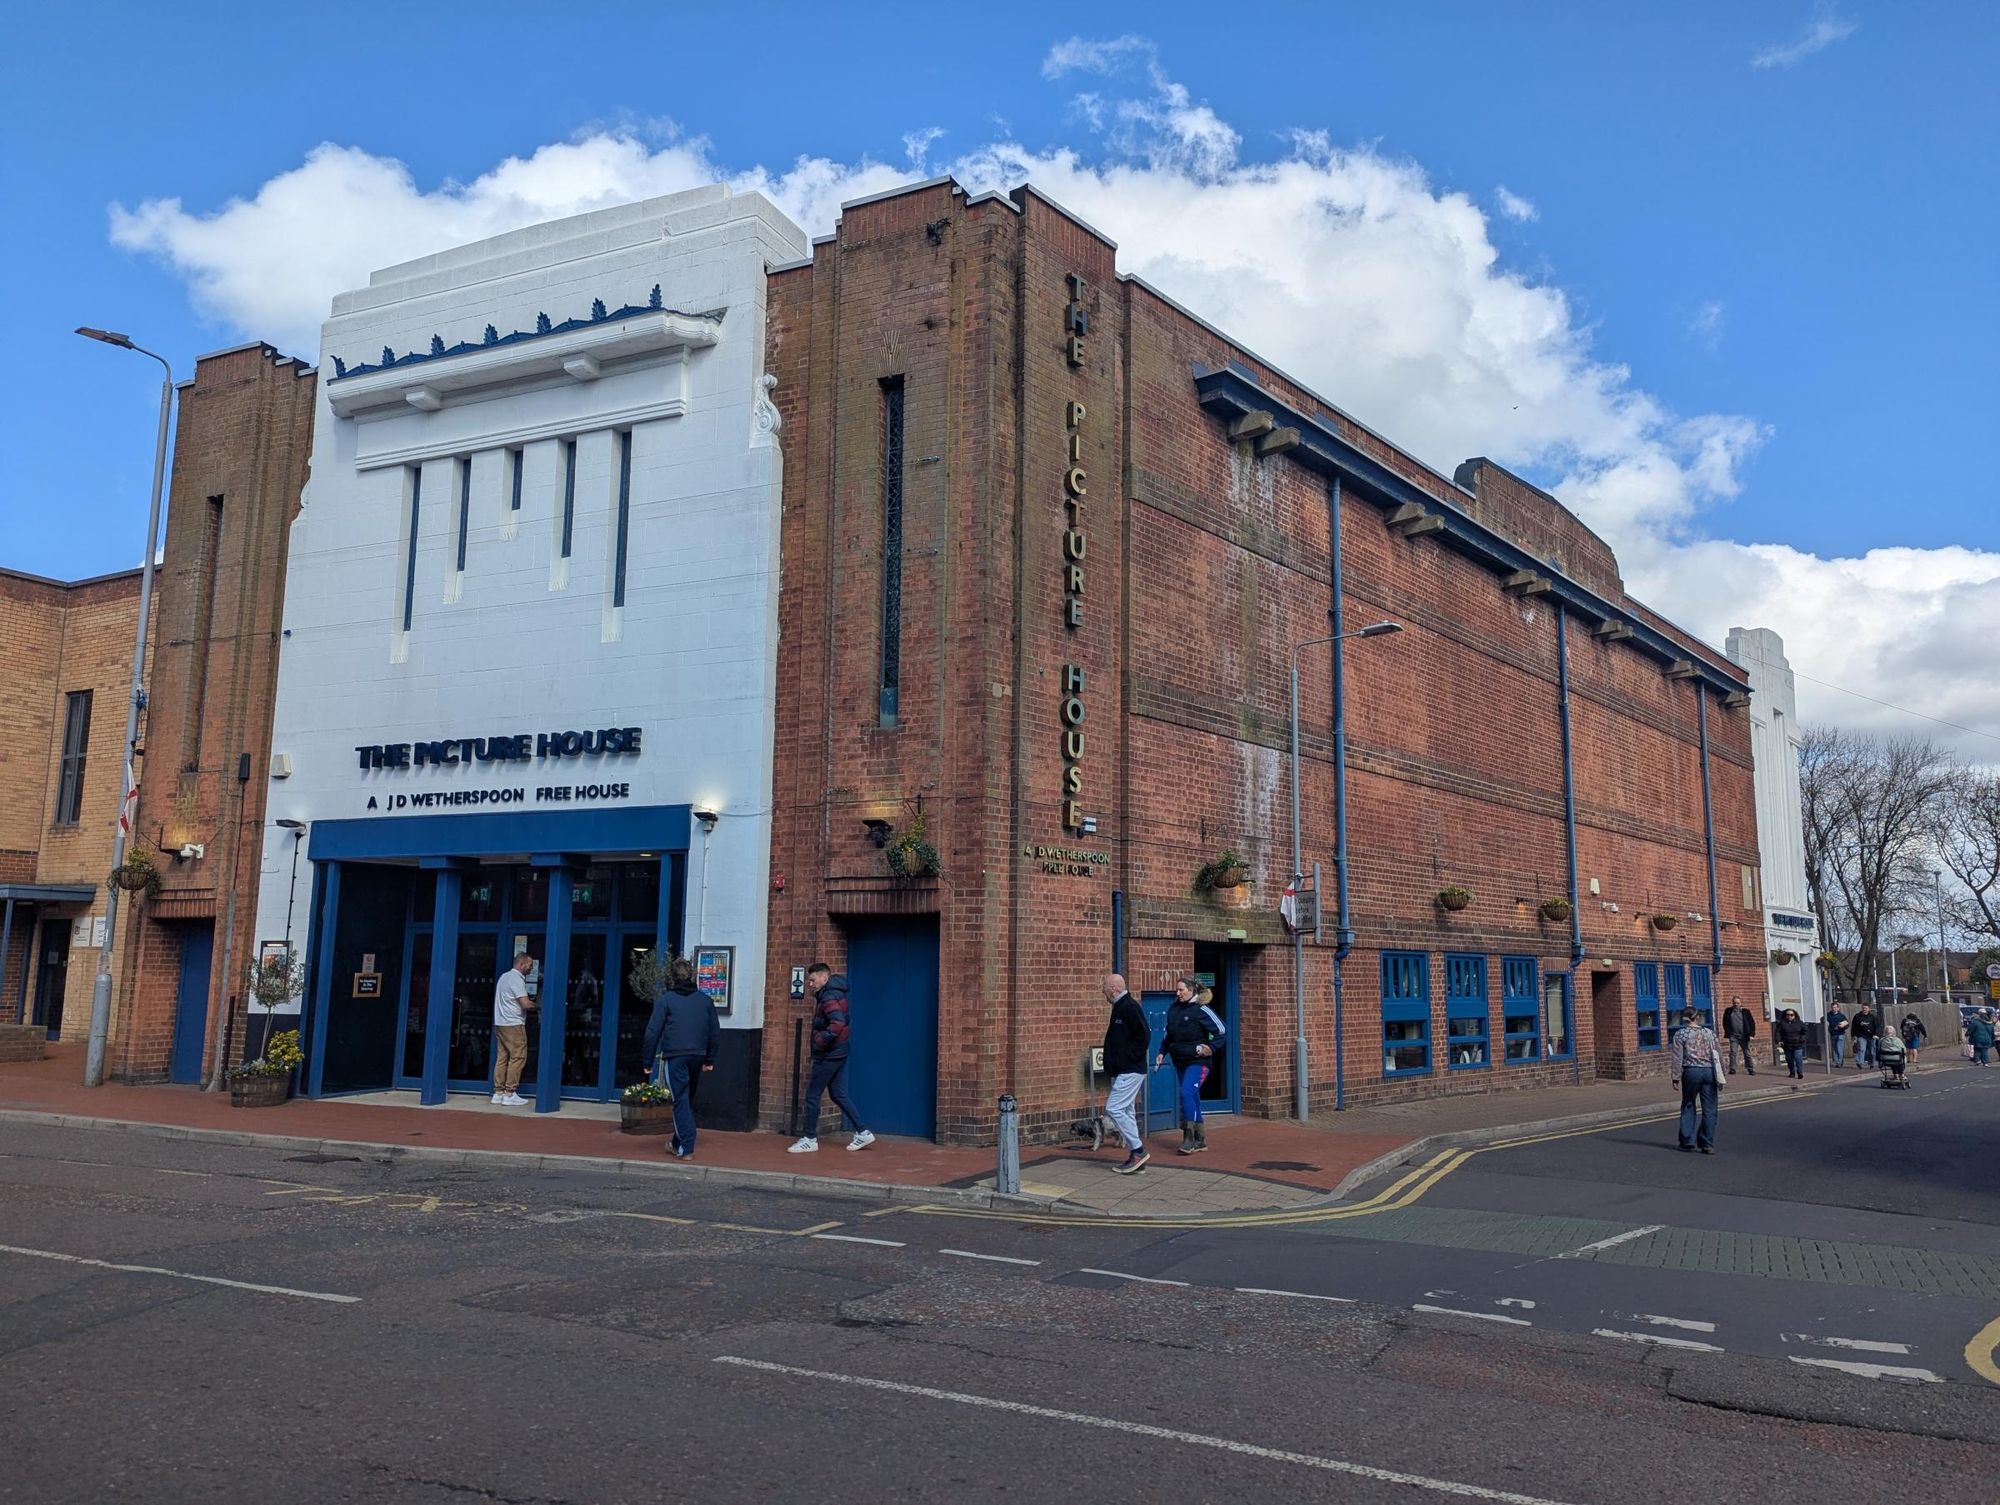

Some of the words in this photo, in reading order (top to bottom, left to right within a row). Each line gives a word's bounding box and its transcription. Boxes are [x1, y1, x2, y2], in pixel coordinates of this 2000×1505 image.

[1066, 272, 1088, 367] THE
[1064, 401, 1087, 628] PICTURE
[355, 743, 410, 769] THE
[414, 735, 532, 766] PICTURE
[537, 727, 642, 757] HOUSE
[1061, 664, 1085, 828] HOUSE
[367, 796, 378, 810] A
[387, 795, 393, 812] J
[397, 794, 407, 808] D
[410, 788, 524, 809] WETHERSPOON
[536, 786, 571, 802] FREE
[575, 783, 629, 800] HOUSE
[1024, 845, 1032, 857] A
[1046, 846, 1110, 864] WETHERSPOON
